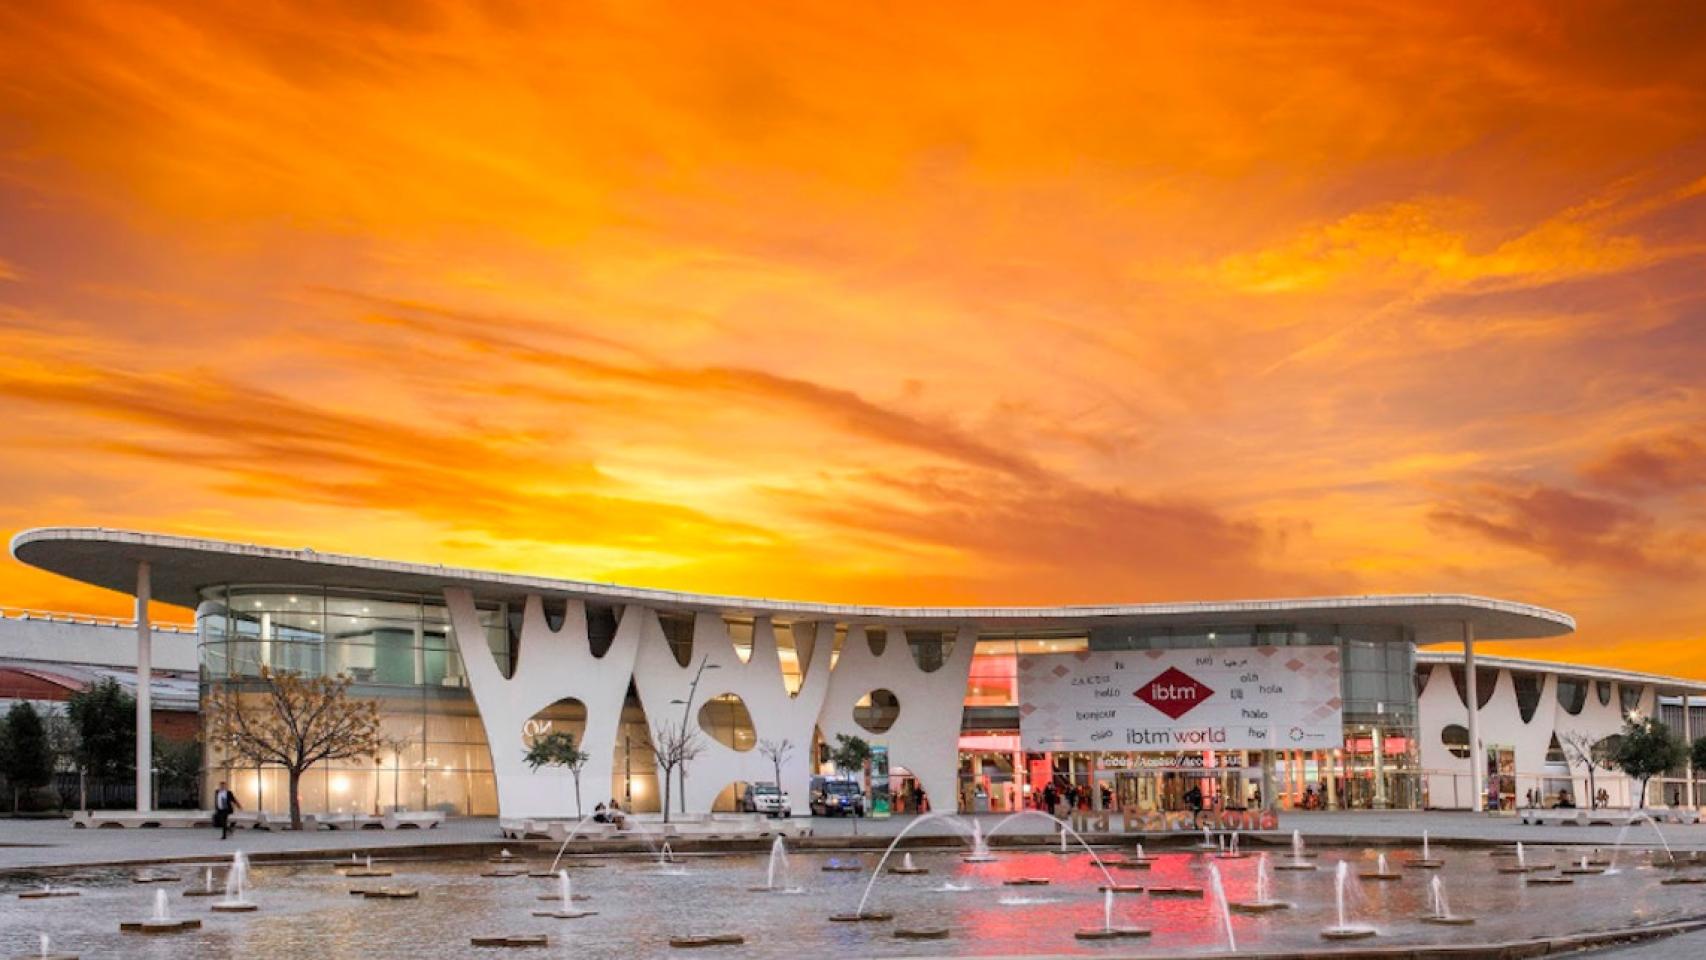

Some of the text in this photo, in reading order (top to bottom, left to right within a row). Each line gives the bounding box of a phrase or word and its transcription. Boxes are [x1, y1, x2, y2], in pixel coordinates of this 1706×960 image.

[1151, 683, 1196, 700] ibtm
[1259, 684, 1283, 694] hola
[1075, 710, 1116, 721] bonjour
[1126, 727, 1226, 744] ibtm world
